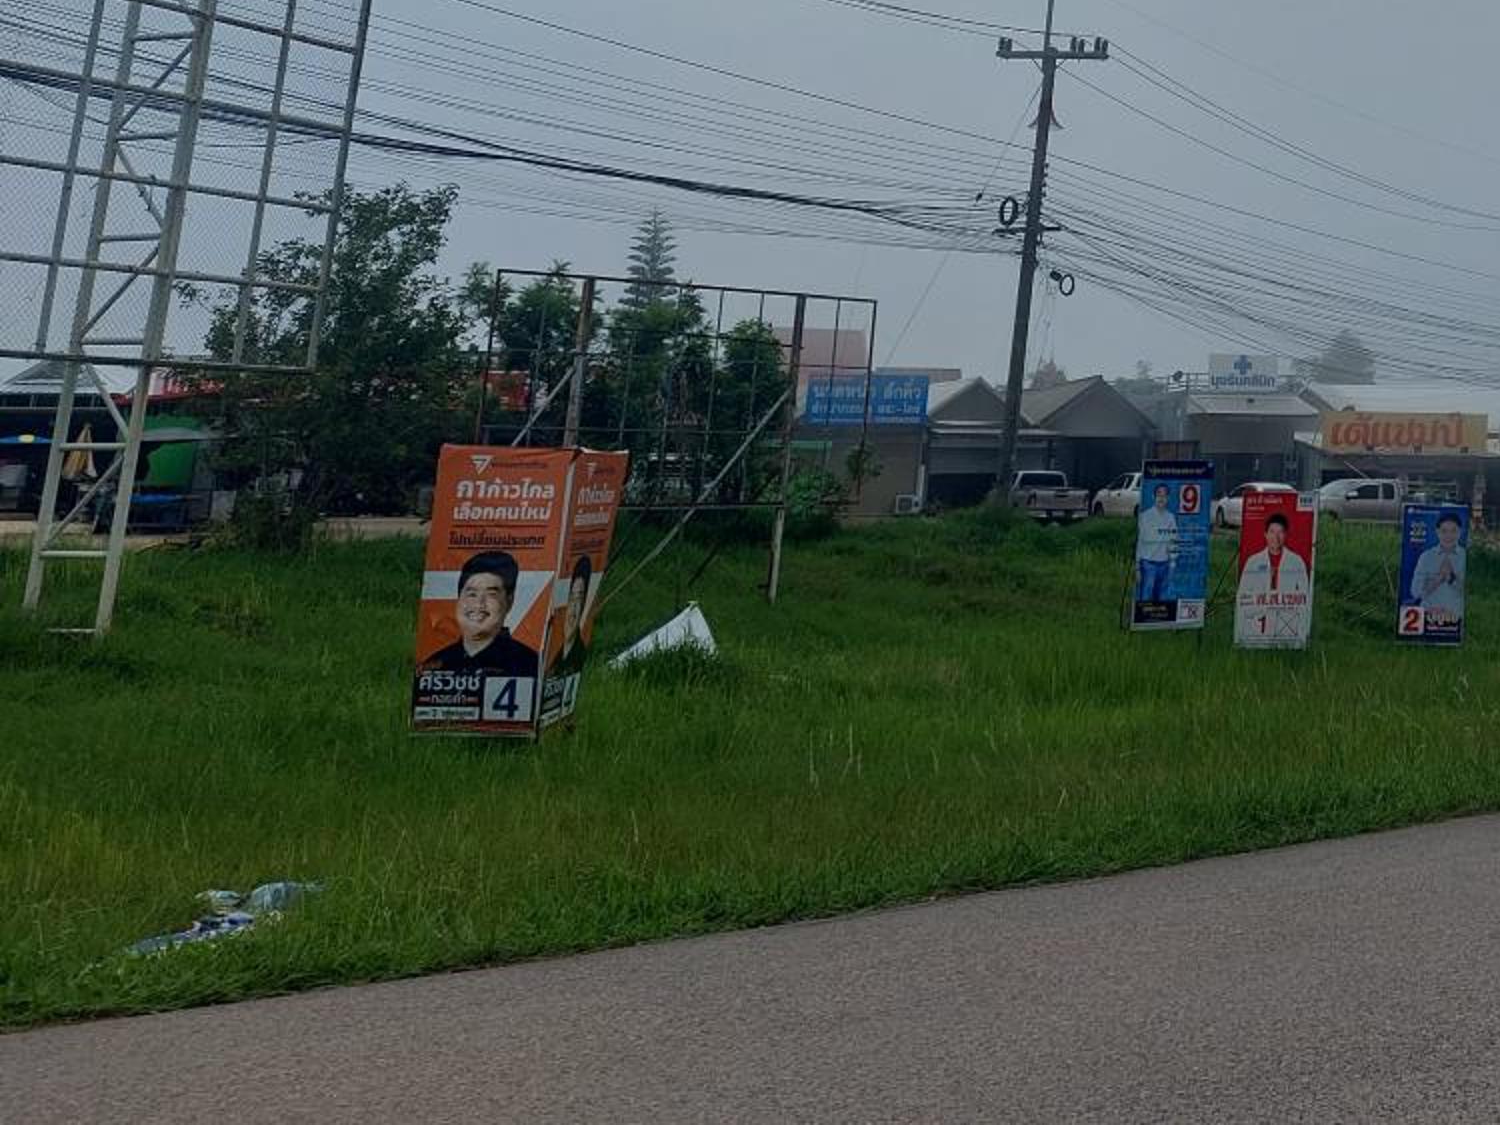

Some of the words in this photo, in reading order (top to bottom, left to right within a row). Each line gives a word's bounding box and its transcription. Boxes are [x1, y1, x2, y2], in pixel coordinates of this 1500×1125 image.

[456, 478, 555, 499] กาก้าวไกล
[1182, 484, 1199, 512] 9
[1257, 615, 1266, 634] 1
[1403, 608, 1419, 632] 2
[492, 678, 519, 718] 4
